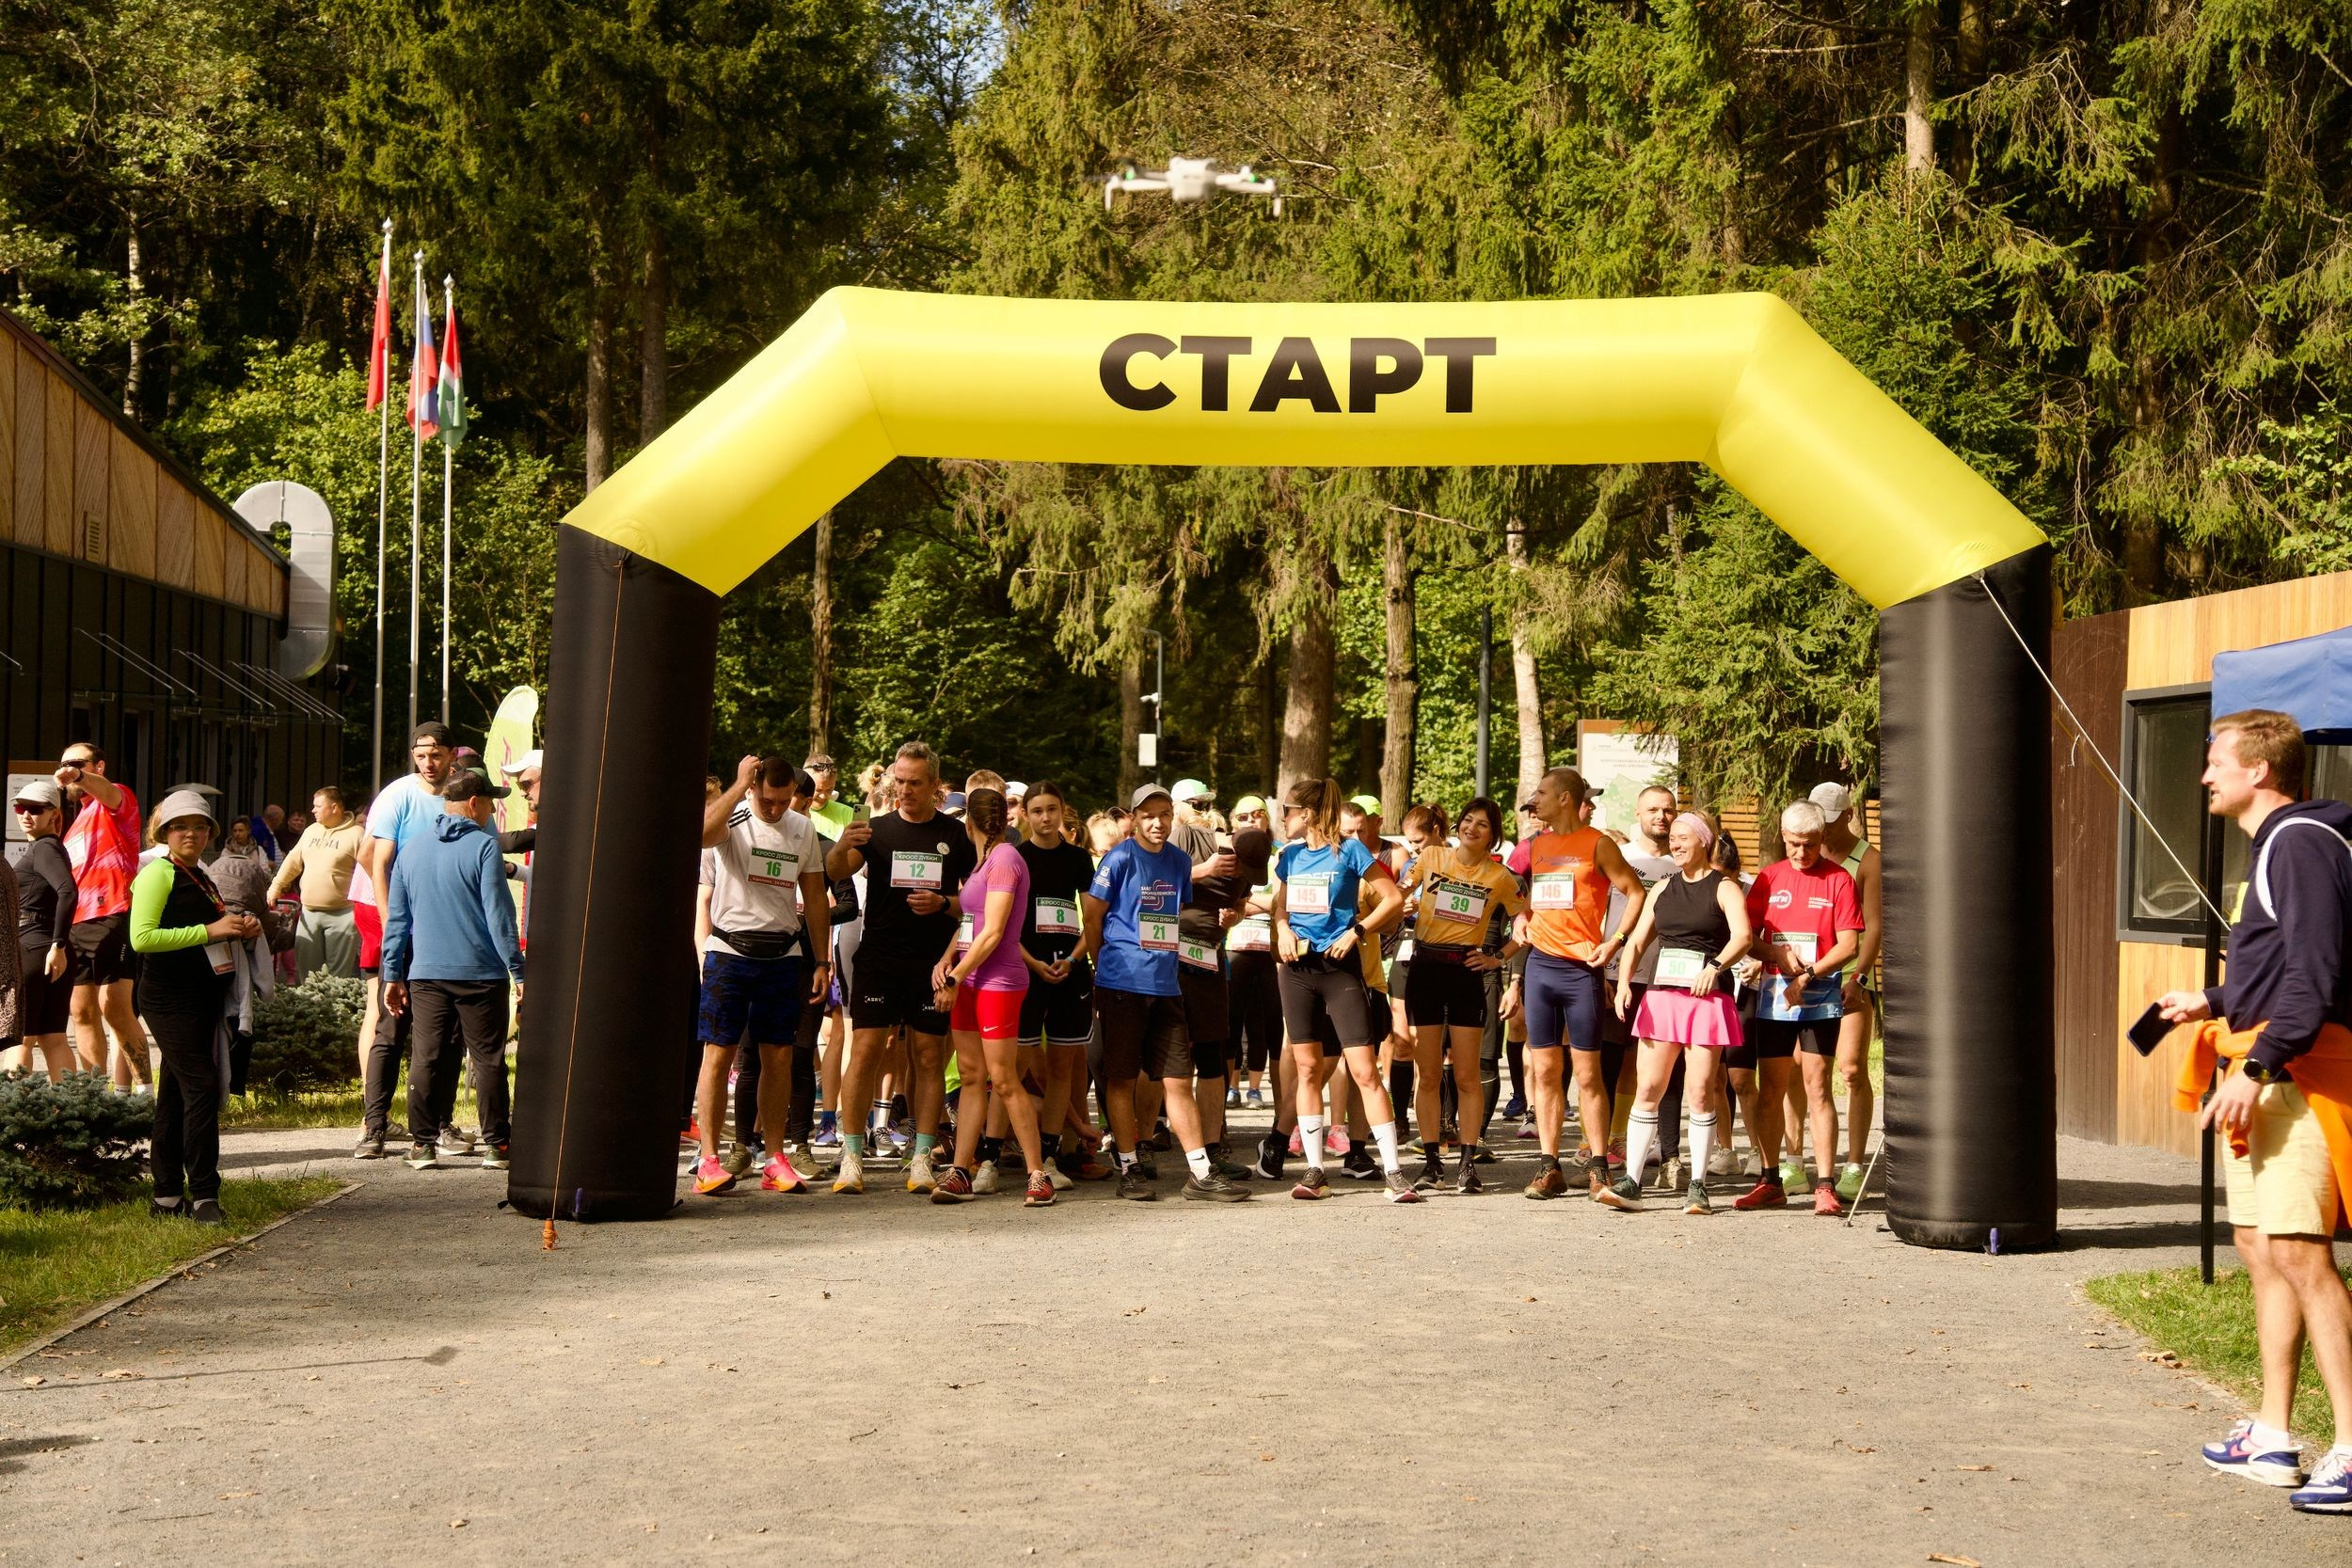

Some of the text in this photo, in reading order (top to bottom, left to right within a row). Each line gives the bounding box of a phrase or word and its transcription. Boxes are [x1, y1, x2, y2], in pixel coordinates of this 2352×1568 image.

[1100, 333, 1497, 413] СТАРТ
[766, 861, 782, 877] 16
[909, 863, 925, 878] 12
[1297, 889, 1316, 903] 145
[1444, 885, 1463, 894] КРОСС
[1541, 884, 1561, 898] 146
[1451, 895, 1470, 912] 39
[1057, 909, 1064, 923] 8
[1152, 925, 1166, 940] 21
[1181, 936, 1198, 944] КРОСС
[1188, 946, 1203, 960] 40
[1669, 960, 1686, 975] 50
